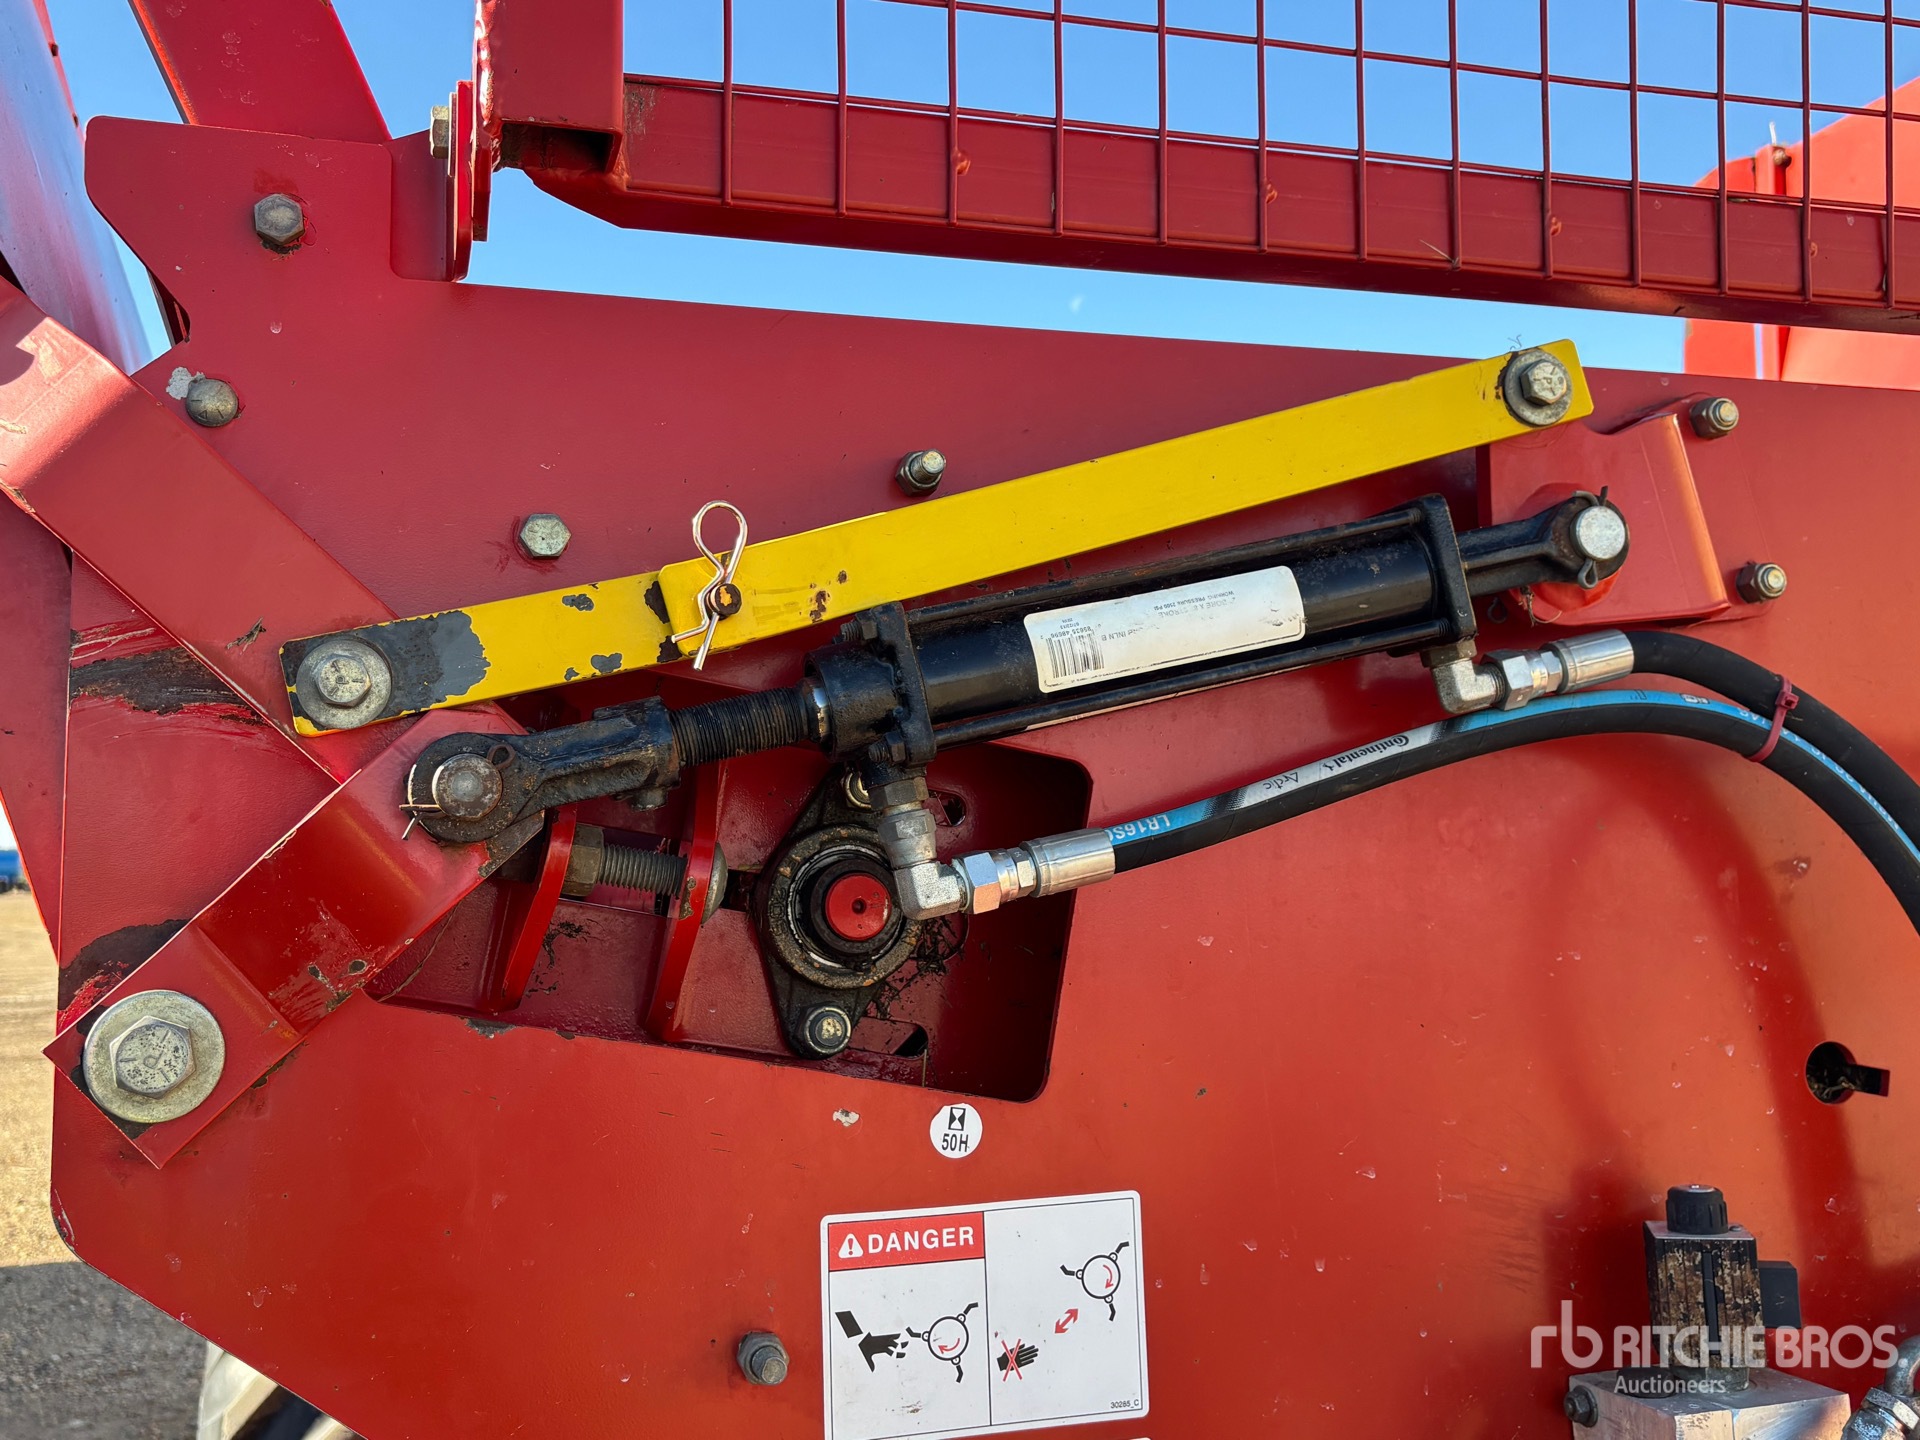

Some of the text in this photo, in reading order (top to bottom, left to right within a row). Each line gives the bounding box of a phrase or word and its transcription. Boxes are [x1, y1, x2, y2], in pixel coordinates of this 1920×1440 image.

[1163, 601, 1176, 609] 2500
[1177, 595, 1206, 605] PRESSURE
[1108, 630, 1127, 640] INLN
[1332, 735, 1409, 769] Continental
[1263, 771, 1299, 790] Arctic
[941, 1132, 969, 1153] 50H
[867, 1225, 975, 1254] DANGER
